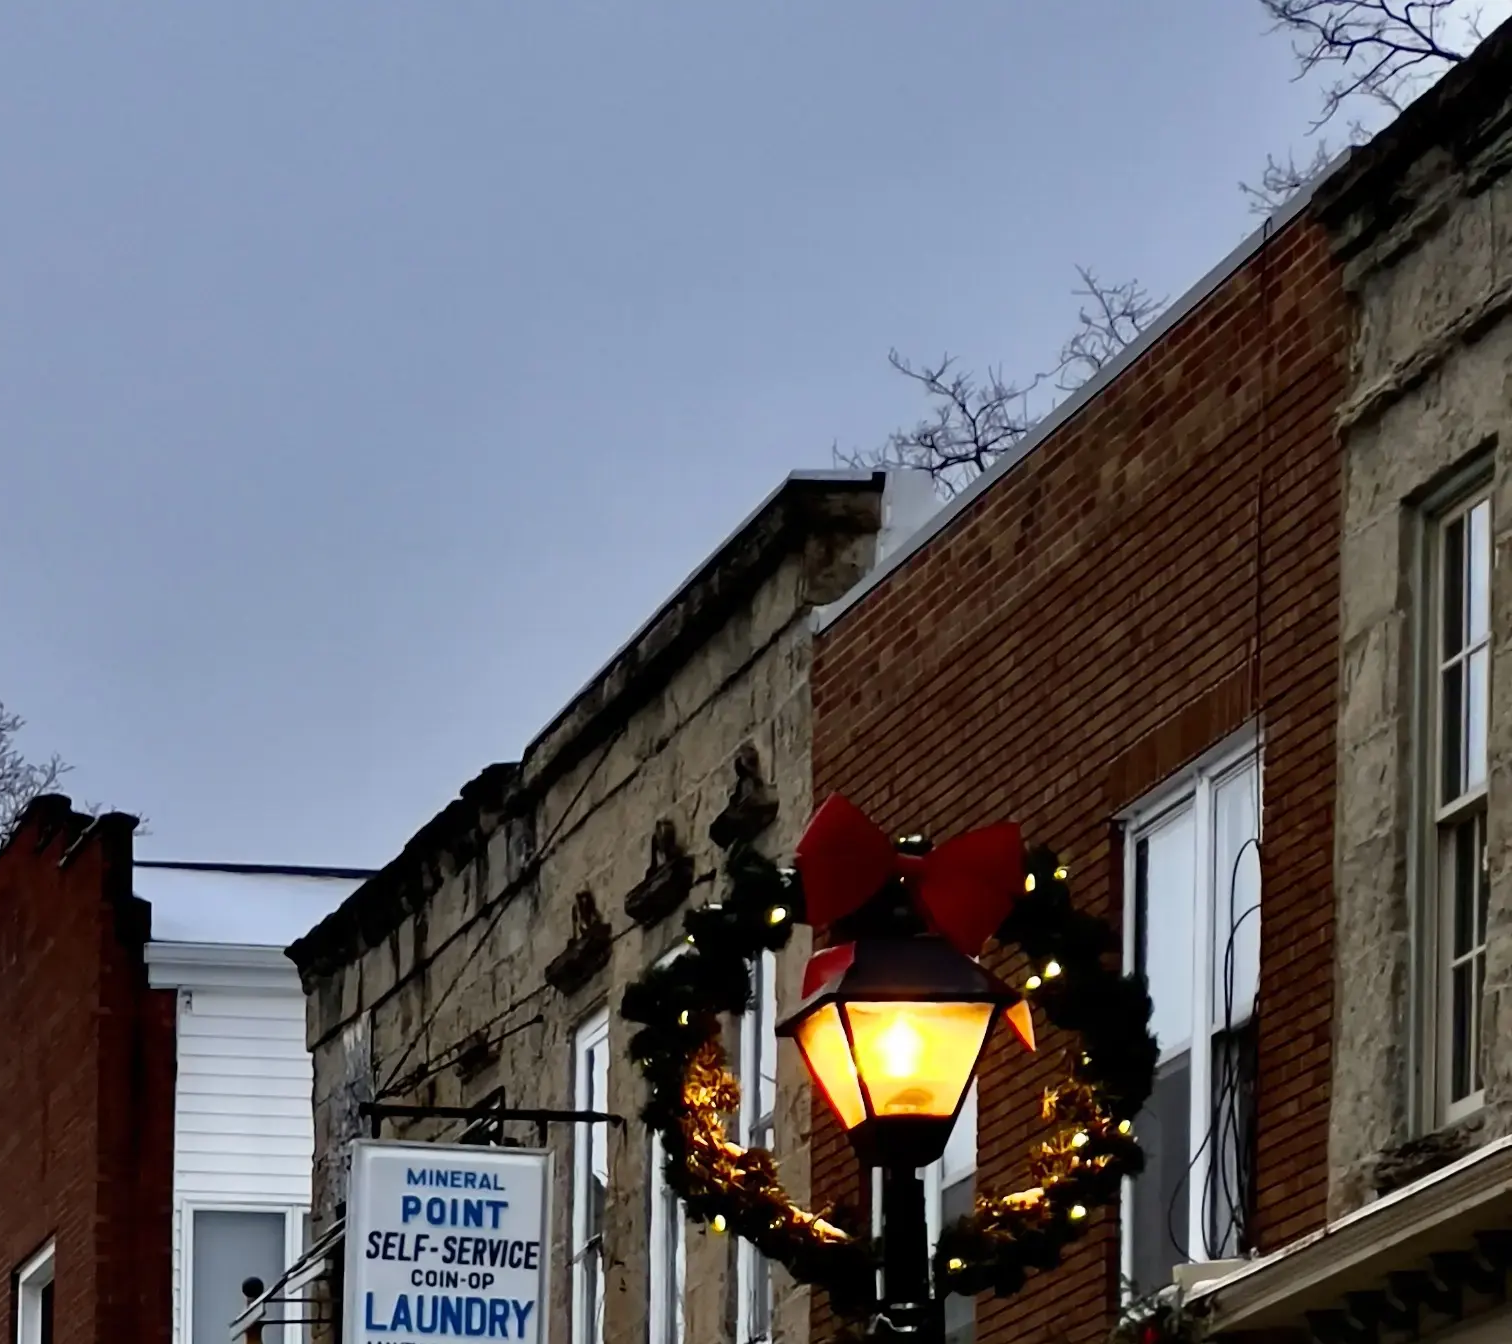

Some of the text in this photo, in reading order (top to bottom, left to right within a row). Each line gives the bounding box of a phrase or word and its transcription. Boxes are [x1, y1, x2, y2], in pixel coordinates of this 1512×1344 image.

[406, 1167, 506, 1192] MINERAL
[401, 1195, 509, 1230] POINT
[365, 1230, 540, 1271] SELF-SERVICE
[411, 1268, 495, 1290] COIN-OP
[364, 1291, 536, 1340] LAUNDRY
